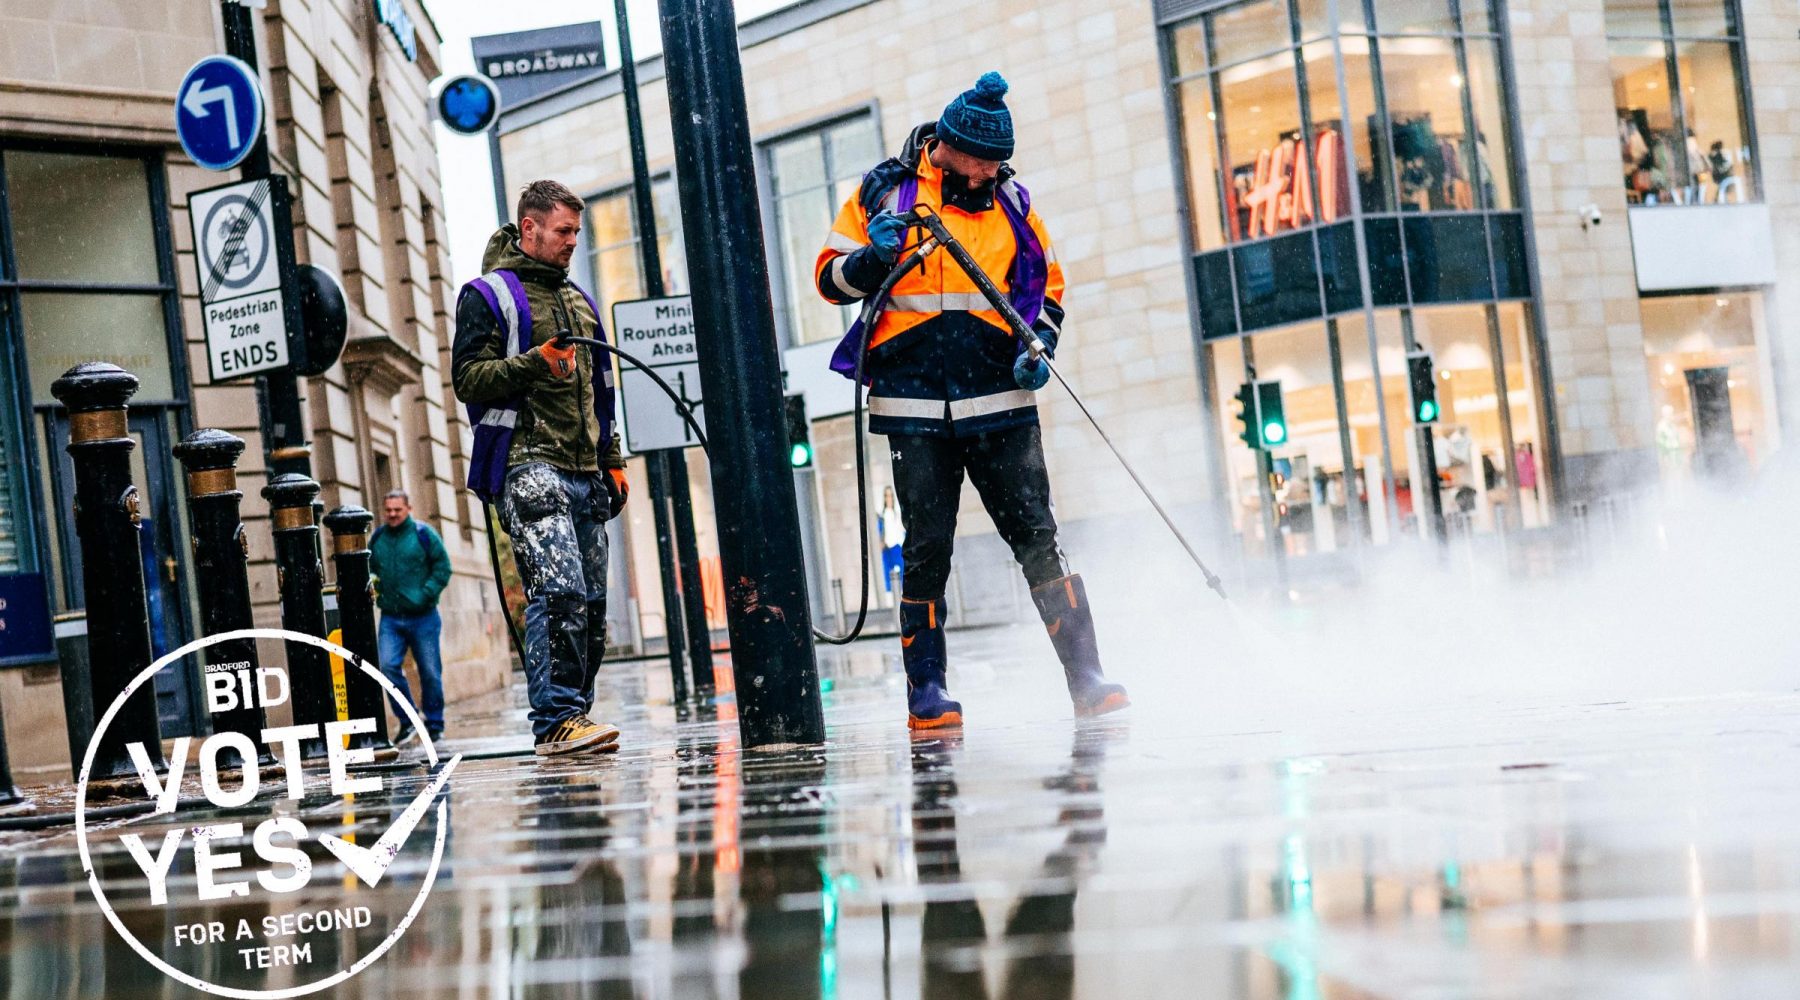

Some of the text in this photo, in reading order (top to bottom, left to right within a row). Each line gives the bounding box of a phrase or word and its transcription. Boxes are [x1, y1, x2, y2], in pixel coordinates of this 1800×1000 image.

[489, 52, 599, 77] BROADWAY
[210, 300, 278, 324] Pedestrian
[656, 304, 692, 319] Mini
[229, 323, 261, 339] Zone
[623, 322, 695, 342] Roundab
[221, 341, 278, 372] ENDS
[652, 342, 695, 357] Ahea
